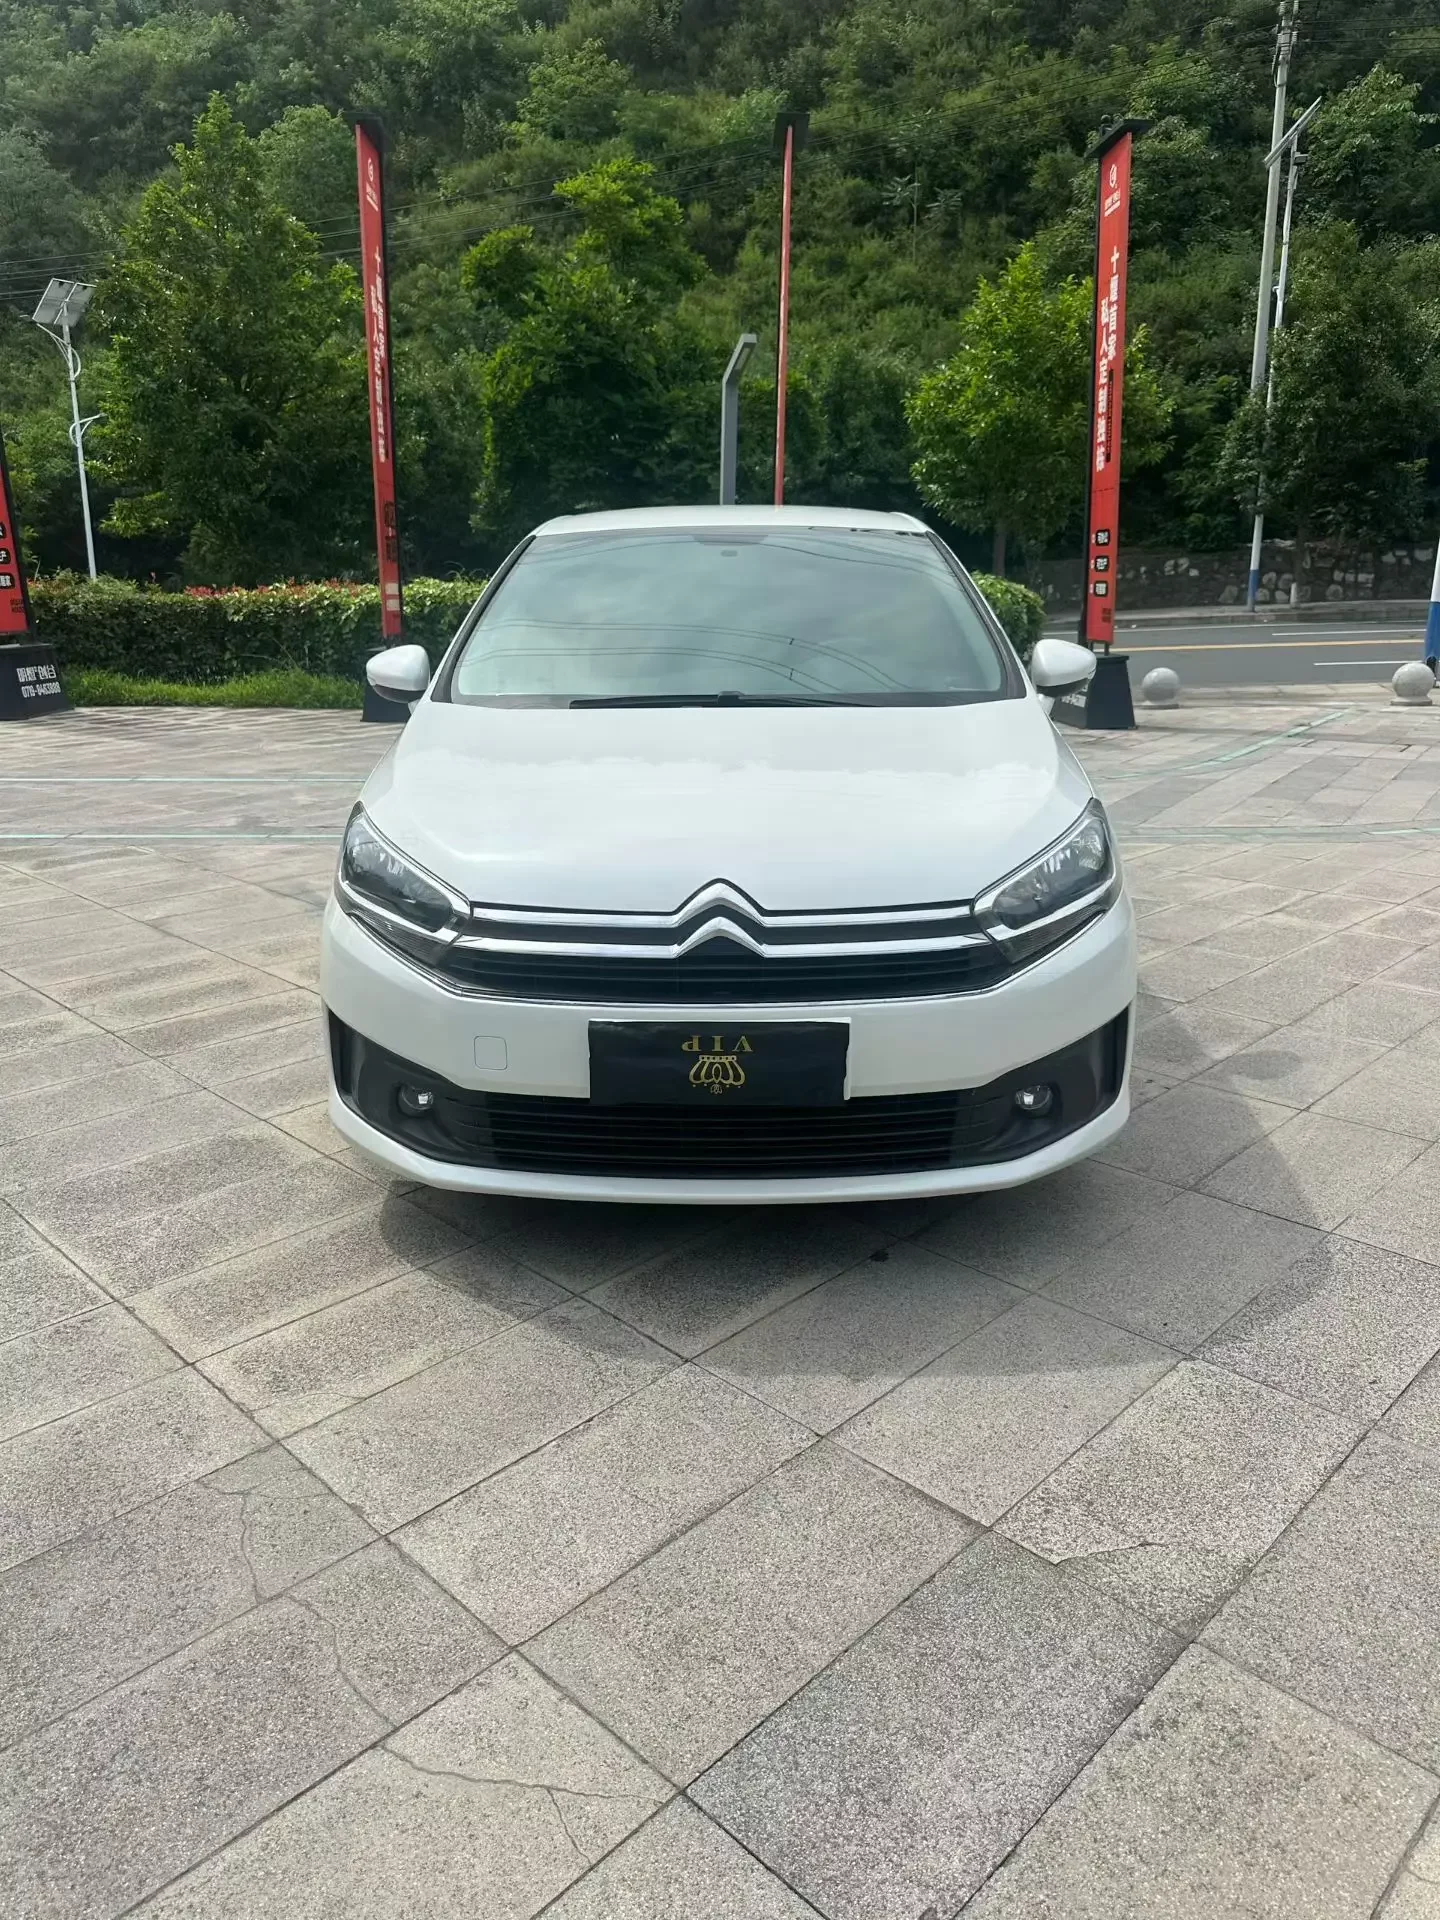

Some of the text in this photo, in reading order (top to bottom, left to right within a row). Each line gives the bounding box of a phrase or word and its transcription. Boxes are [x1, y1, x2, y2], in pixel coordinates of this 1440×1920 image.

[1108, 245, 1120, 361] 十堰首家
[681, 1035, 753, 1052] VIP
